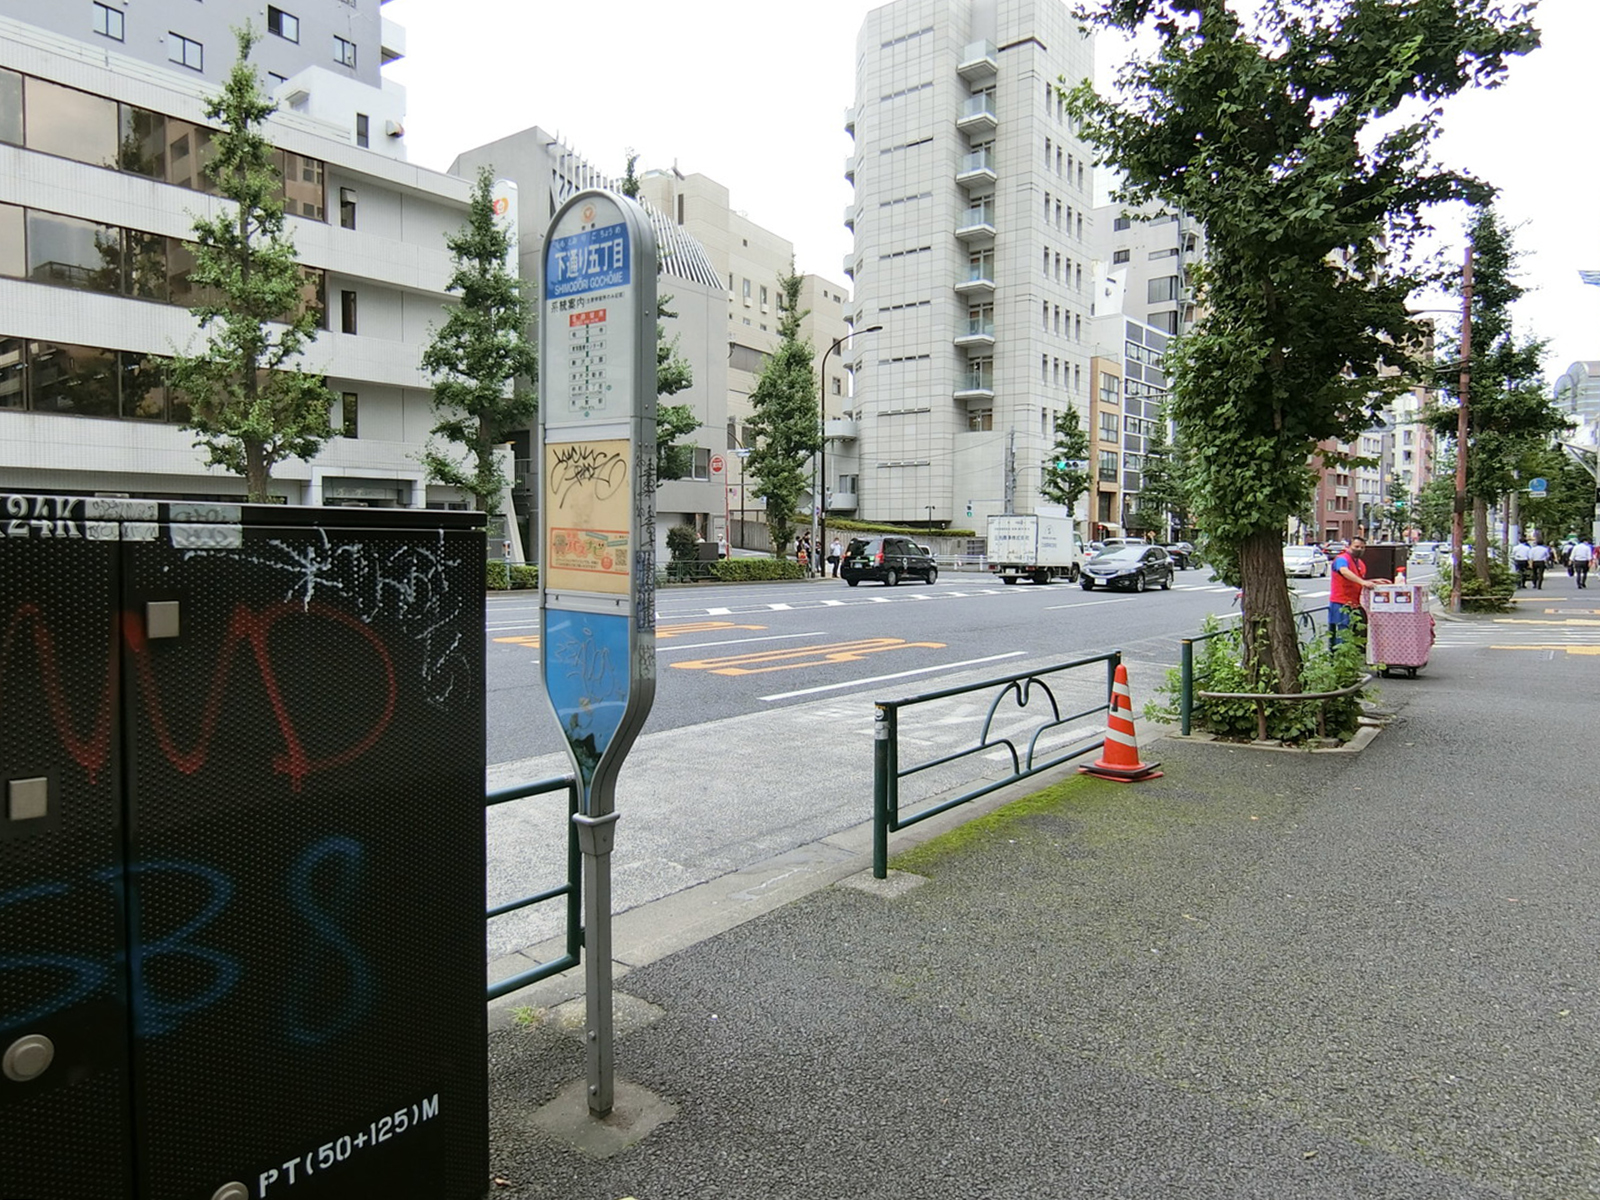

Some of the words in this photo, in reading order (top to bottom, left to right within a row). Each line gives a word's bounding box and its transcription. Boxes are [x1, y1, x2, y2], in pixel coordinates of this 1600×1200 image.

[555, 238, 623, 281] 下通り五丁目
